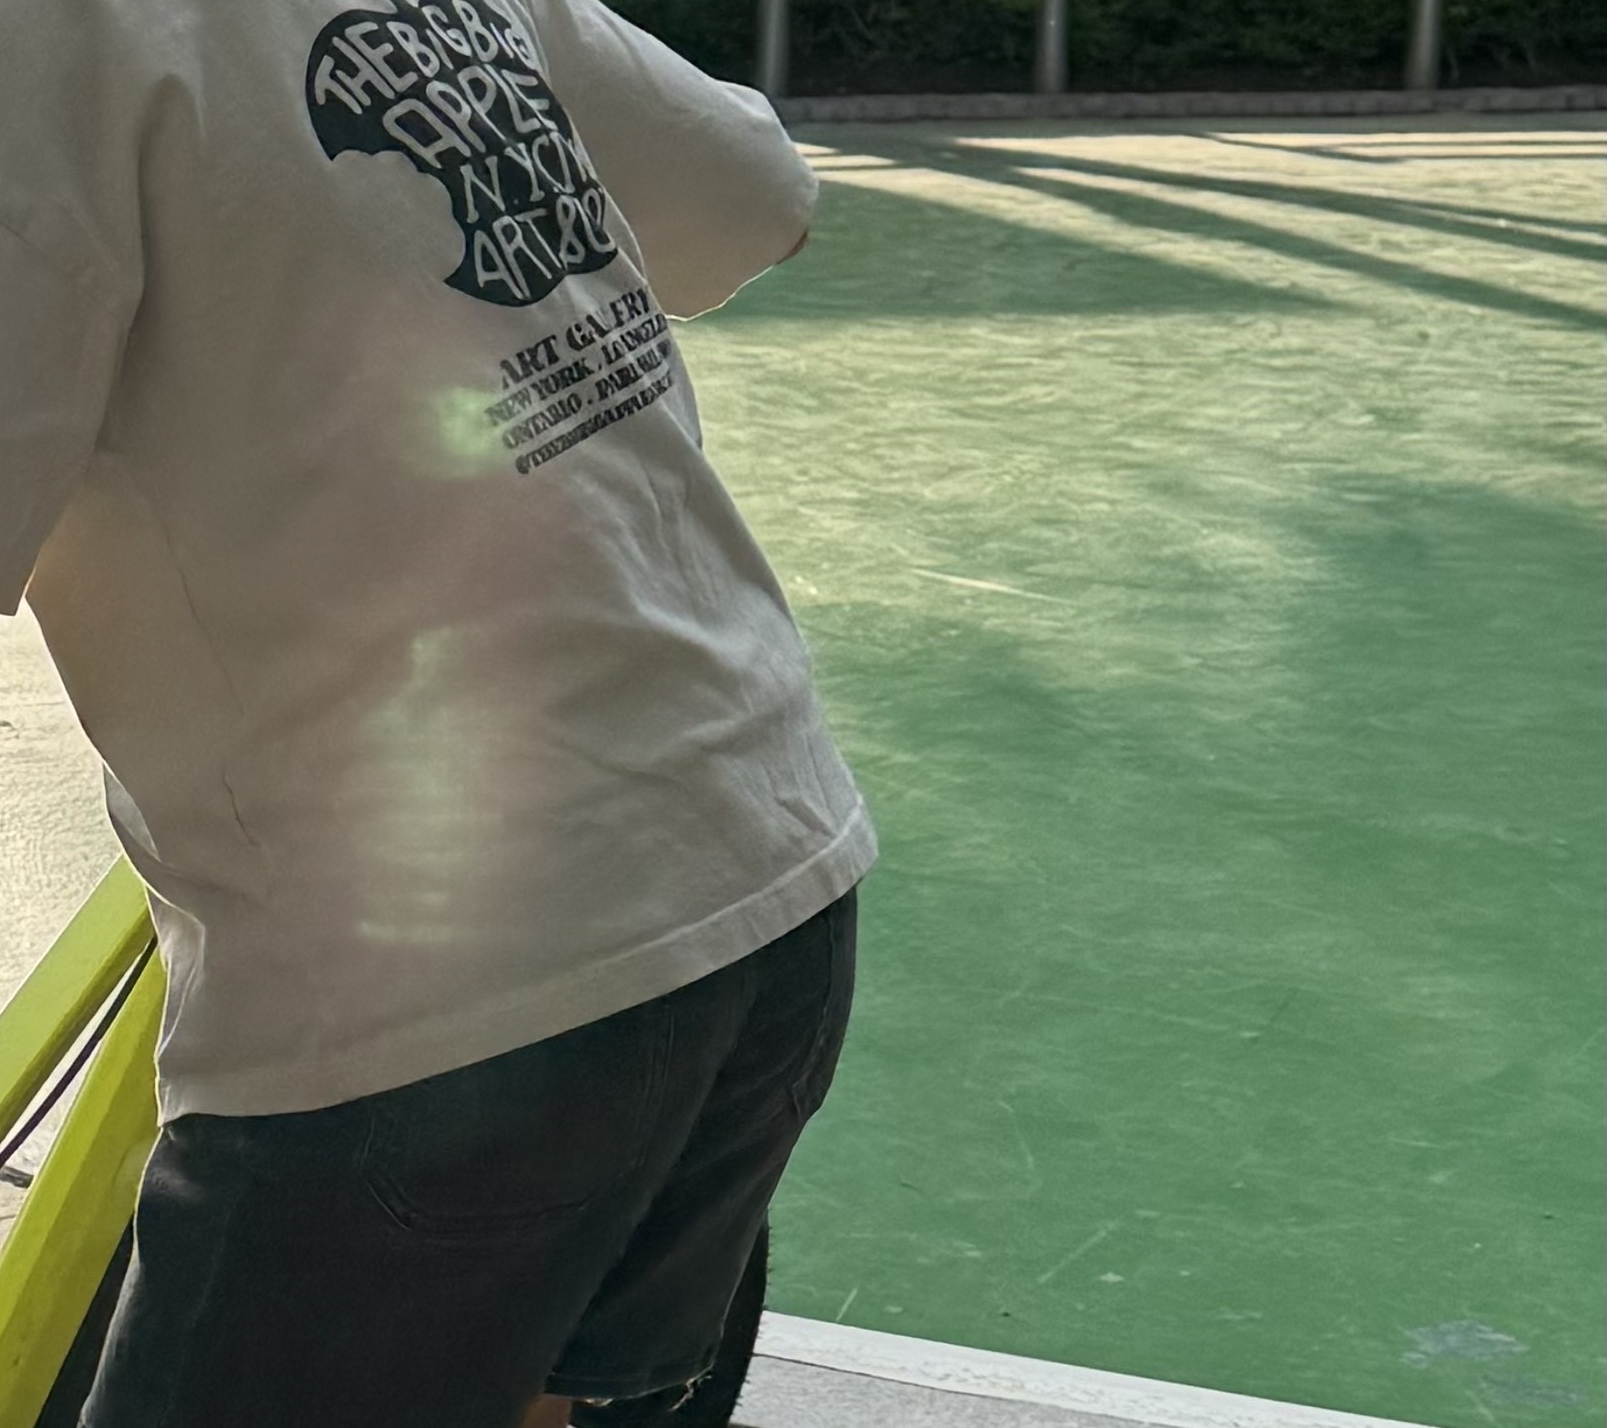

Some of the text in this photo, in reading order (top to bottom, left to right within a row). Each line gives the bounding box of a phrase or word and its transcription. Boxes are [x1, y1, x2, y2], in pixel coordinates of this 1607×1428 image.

[314, 21, 420, 114] THE
[386, 4, 473, 78] BIG
[382, 63, 560, 170] APPLE
[473, 207, 563, 300] ART
[499, 334, 560, 390] ART
